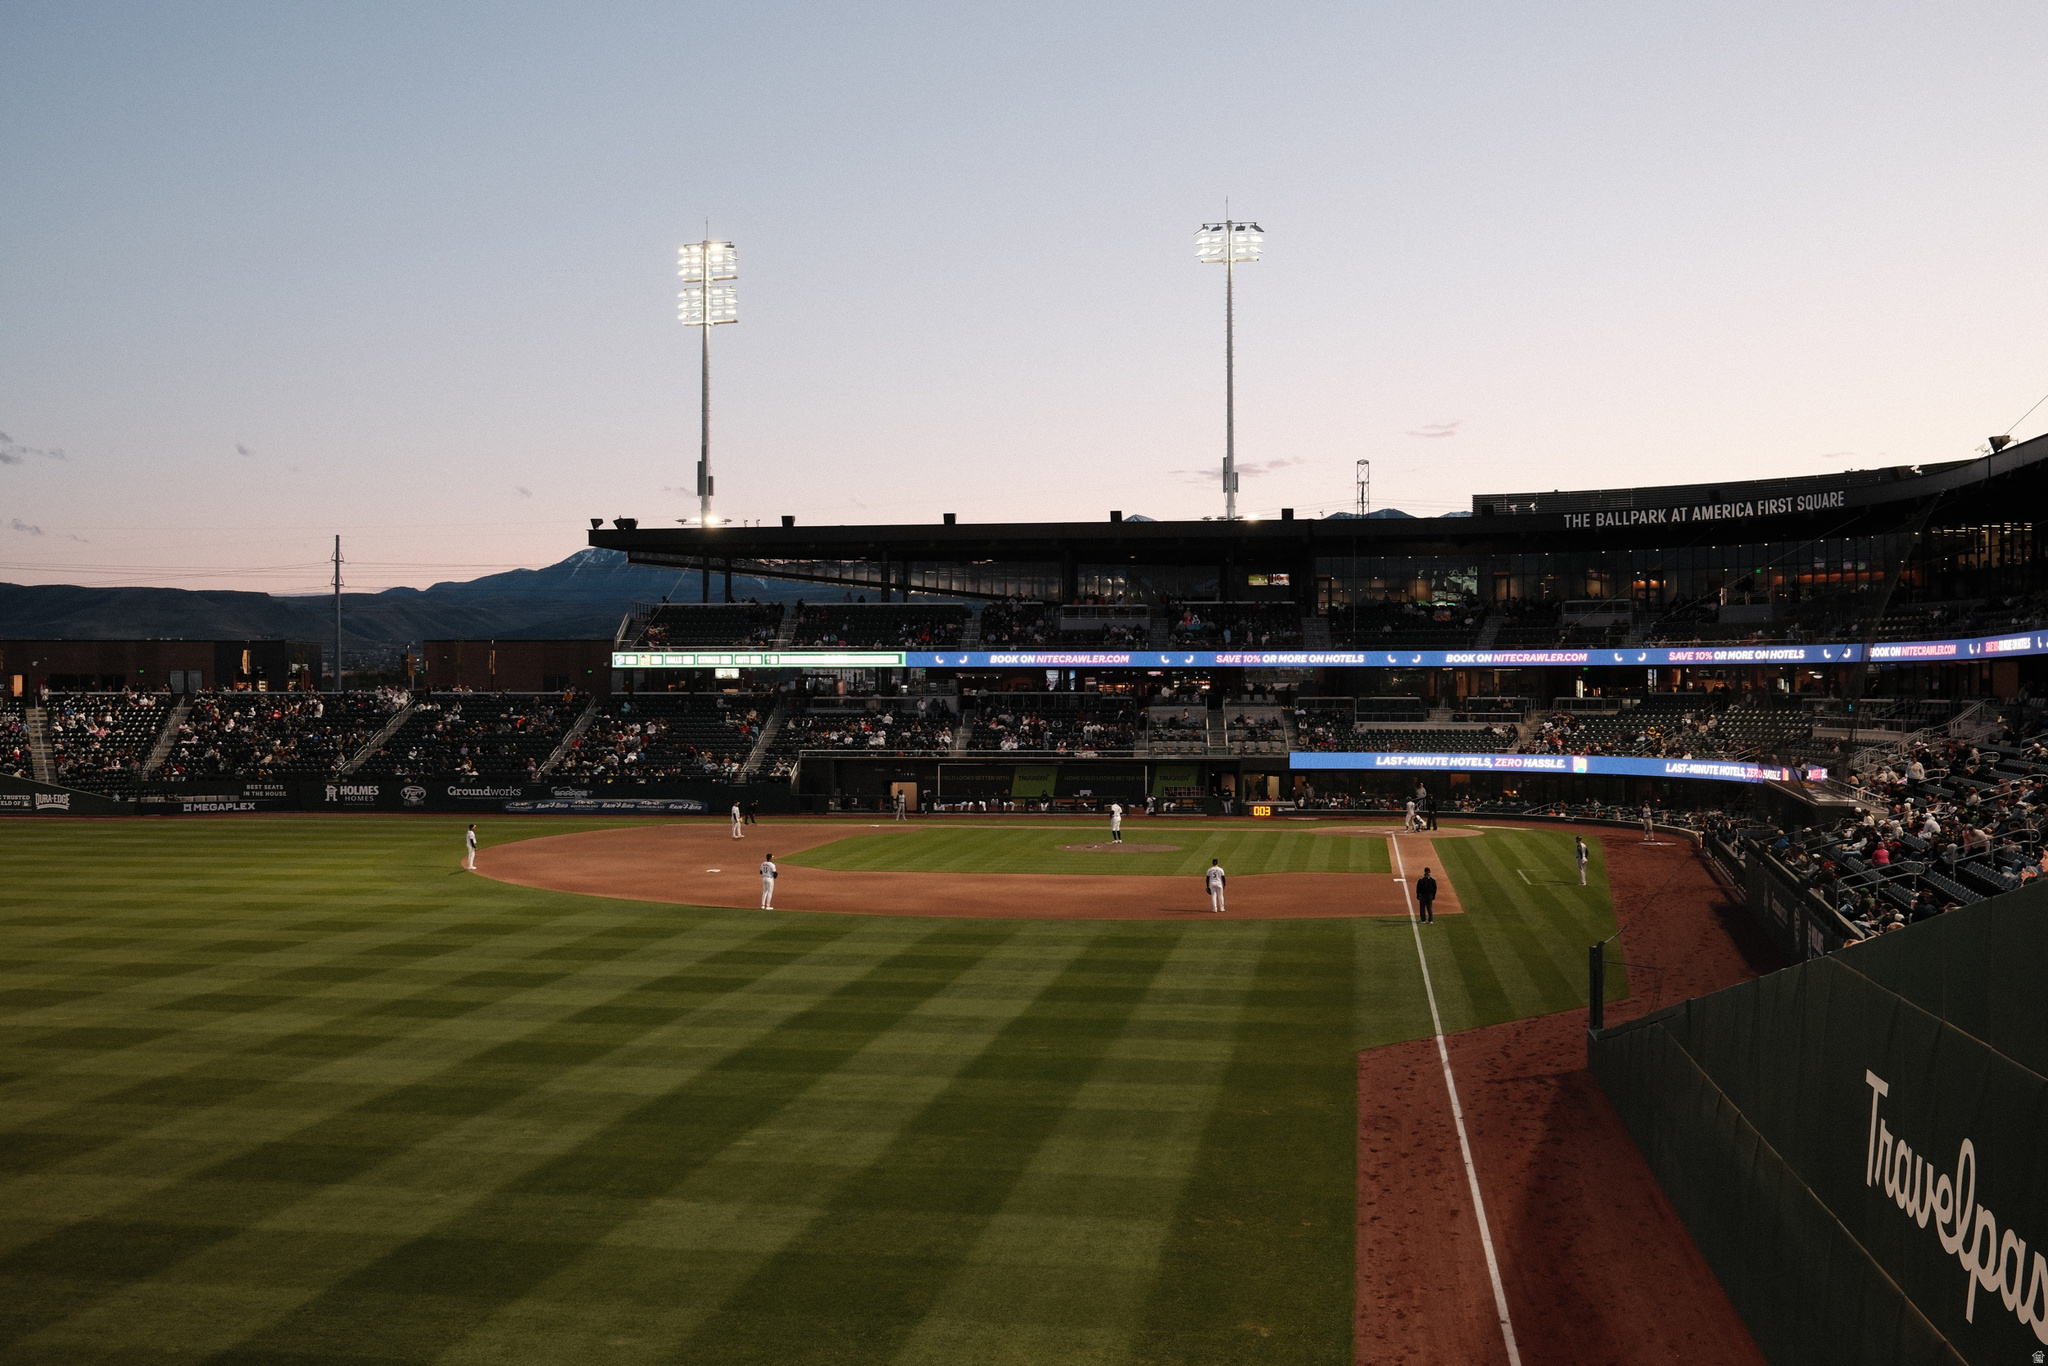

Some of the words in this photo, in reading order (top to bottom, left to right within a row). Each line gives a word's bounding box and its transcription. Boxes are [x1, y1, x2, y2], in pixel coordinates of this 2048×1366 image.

[1563, 513, 1591, 529] THE
[1595, 508, 1667, 527] BALLPARK
[1671, 507, 1688, 523] AT
[1691, 502, 1754, 521] AMERICA
[1757, 497, 1794, 516] FIRST
[1796, 490, 1845, 511] SQUARE
[1668, 651, 1693, 661] SAVE
[1695, 651, 1713, 660] 10%
[1713, 651, 1728, 660] OR
[1728, 651, 1754, 660] MORE
[1754, 650, 1769, 660] ON
[1769, 649, 1805, 660] HOTELS
[1869, 647, 1890, 658] BOOK
[1890, 646, 1901, 657] ON
[1901, 644, 1957, 657] NITECRAWLER.COM
[989, 654, 1019, 664] BOOK
[1020, 654, 1035, 664] ON
[1036, 654, 1130, 664] NITECRAWLER.COM
[1215, 654, 1242, 664] SAVE
[1242, 654, 1261, 664] 10%
[1262, 654, 1278, 663] OR
[1278, 654, 1307, 663] MORE
[1308, 654, 1325, 663] ON
[1325, 654, 1365, 663] HOTELS
[1445, 653, 1476, 663] BOOK
[1476, 653, 1492, 663] ON
[1493, 652, 1588, 662] NITECRAWLER.COM
[1376, 756, 1448, 766] LAST-MINUTE
[1449, 757, 1493, 768] HOTELS,
[1494, 758, 1522, 767] ZERO
[1523, 759, 1566, 768] HASSLE.
[1665, 763, 1719, 774] LAST-MINUTE
[1719, 766, 1746, 779] HOTELS,
[1746, 767, 1763, 778] ZERO
[339, 785, 380, 796] HOLMES
[447, 785, 522, 797] Groundworks
[193, 802, 256, 812] MEGAPLEX
[1253, 806, 1271, 816] 003
